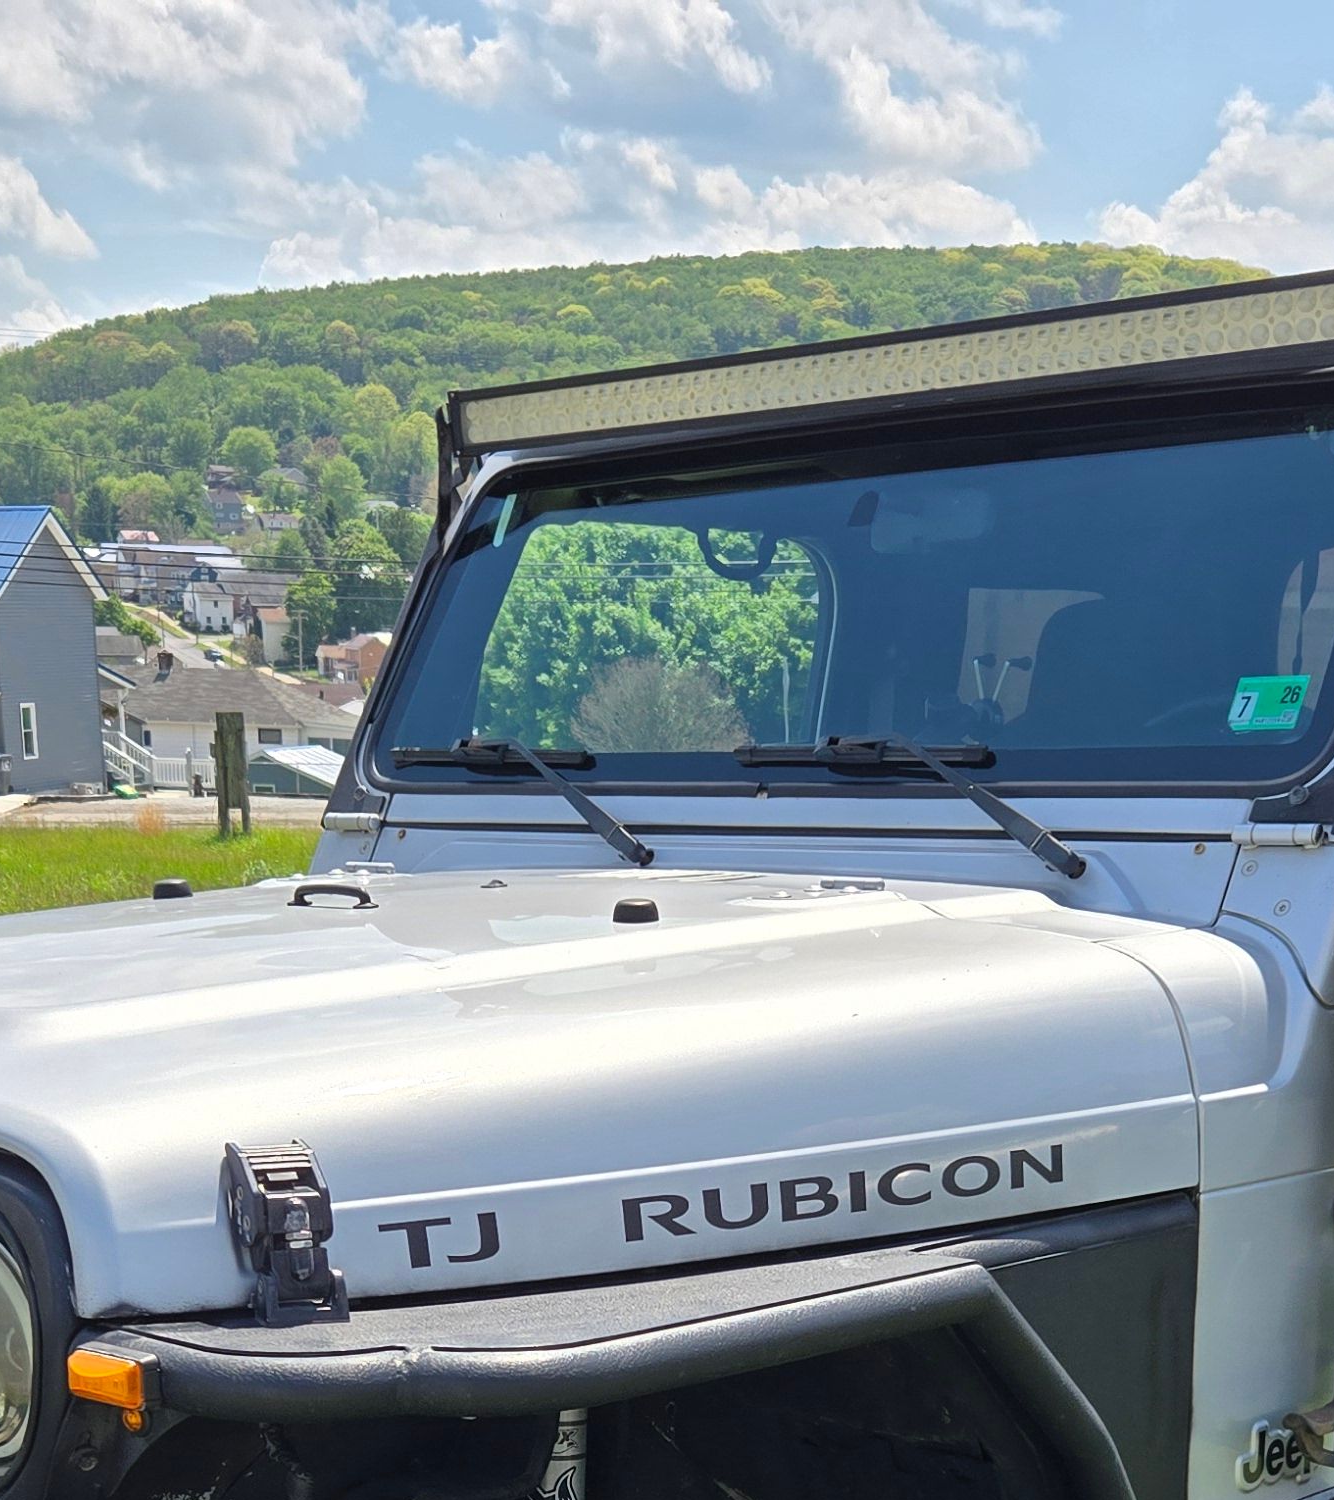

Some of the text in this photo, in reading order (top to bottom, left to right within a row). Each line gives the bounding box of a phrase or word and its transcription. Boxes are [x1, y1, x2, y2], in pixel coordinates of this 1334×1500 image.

[1280, 685, 1302, 704] 26
[1237, 695, 1252, 718] 7
[377, 1143, 1067, 1270] TJ RUBICON
